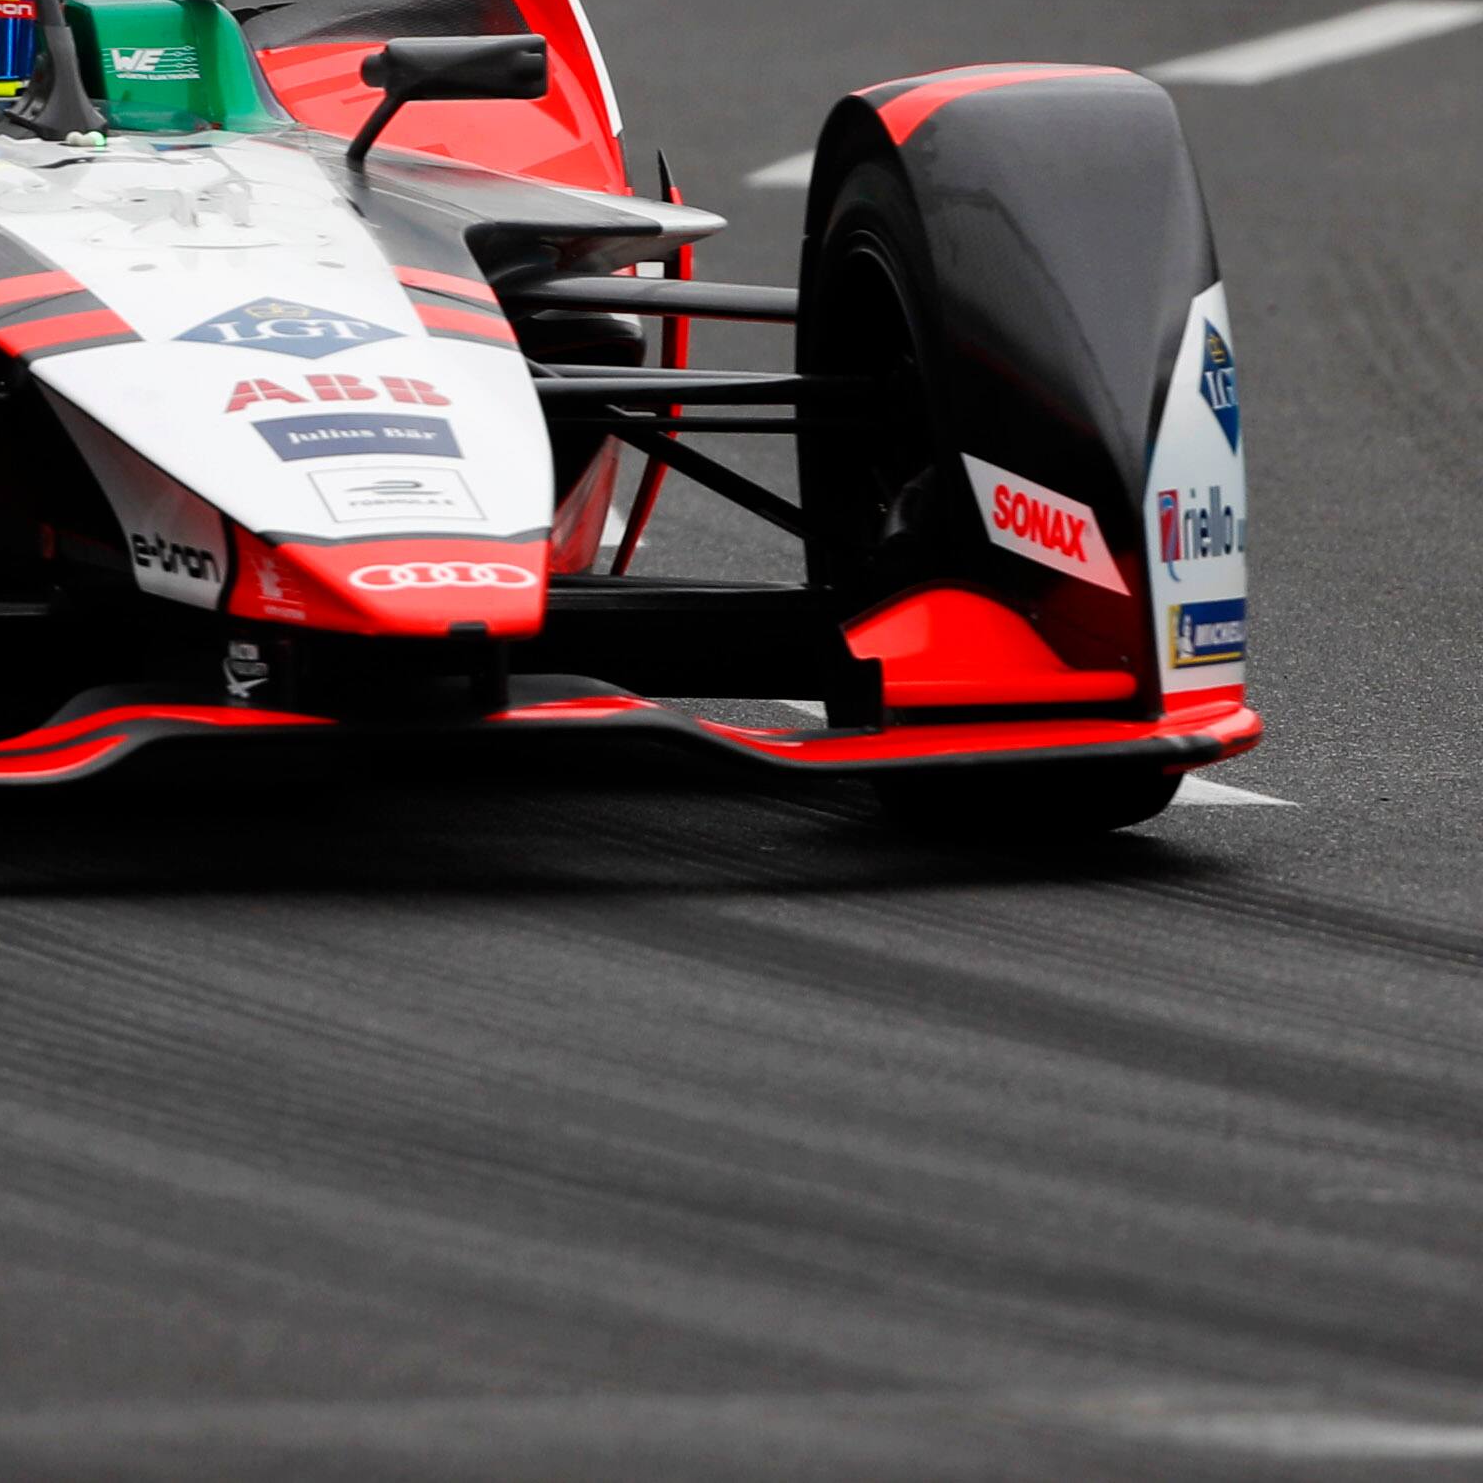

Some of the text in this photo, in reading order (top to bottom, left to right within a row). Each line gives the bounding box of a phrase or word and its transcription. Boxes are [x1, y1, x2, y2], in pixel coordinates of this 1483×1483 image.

[207, 317, 372, 342] LGT
[224, 373, 452, 414] ABB
[1204, 367, 1235, 412] LG
[287, 426, 376, 445] Julius
[992, 483, 1088, 564] SONAX
[131, 532, 222, 584] e-tron
